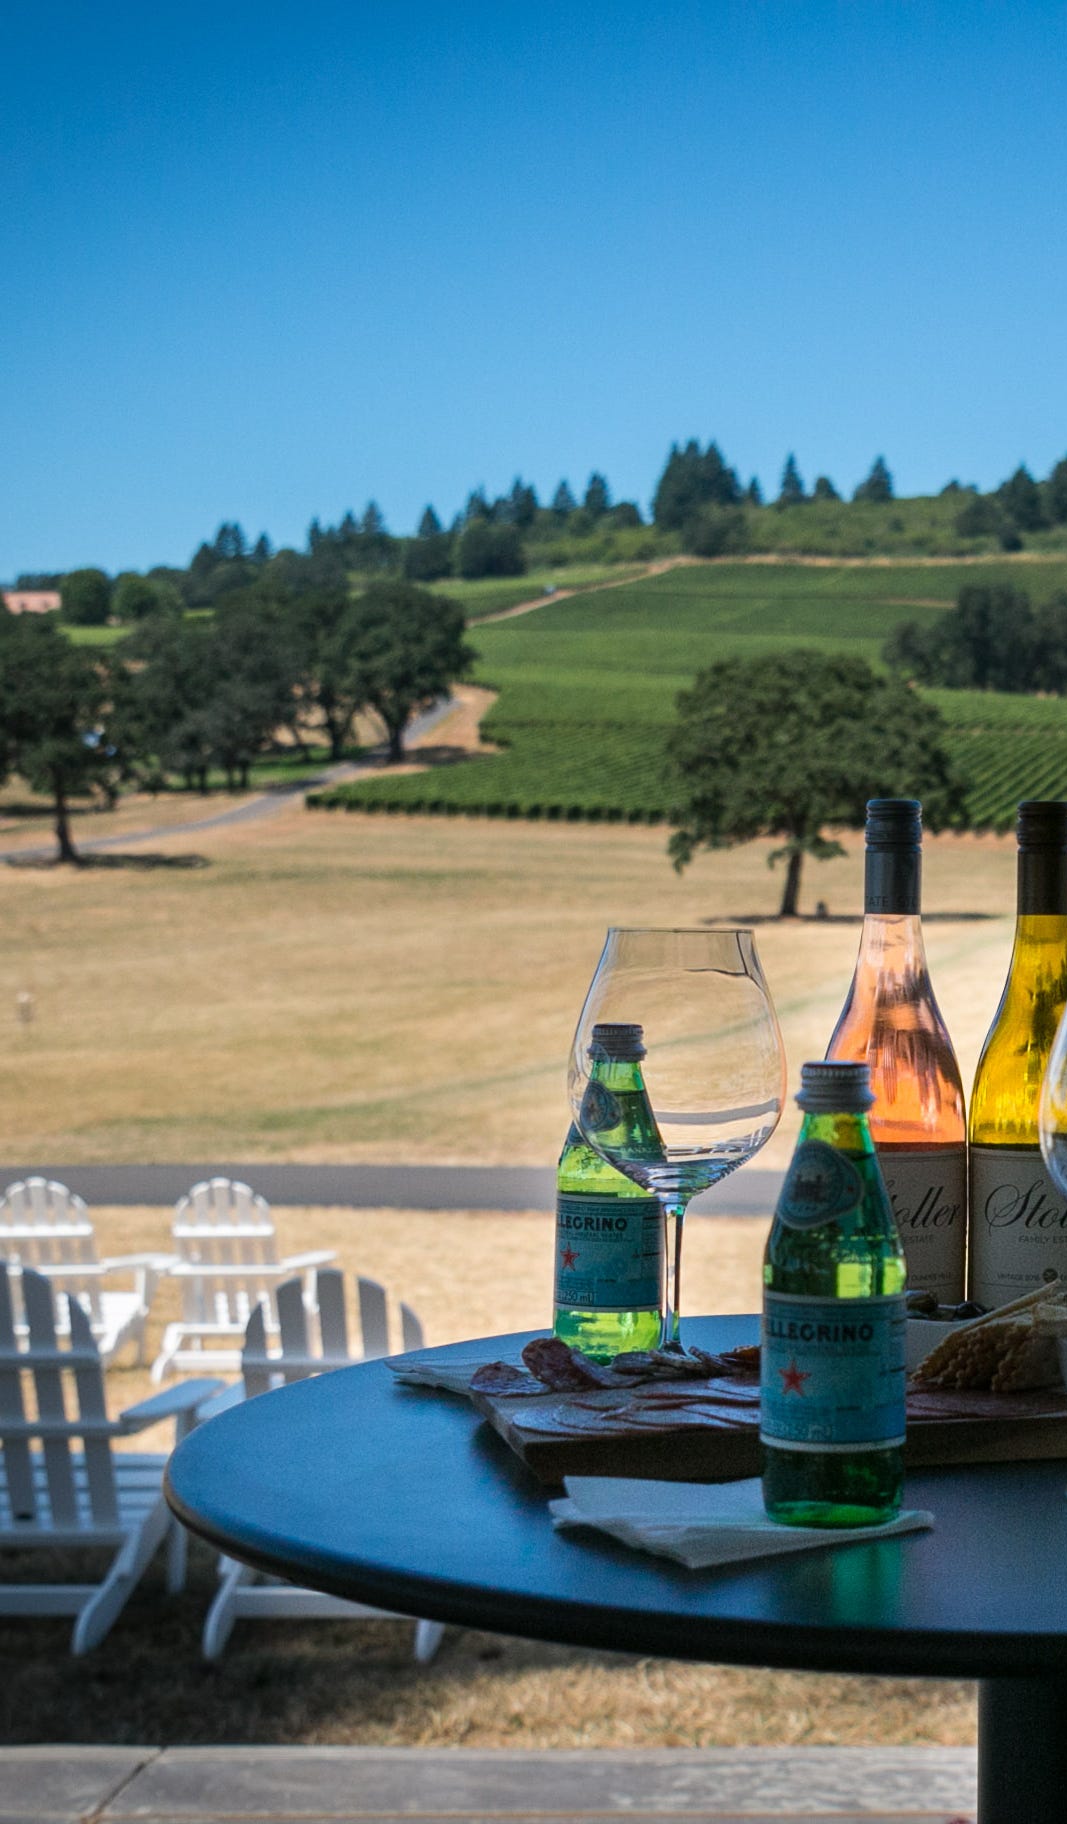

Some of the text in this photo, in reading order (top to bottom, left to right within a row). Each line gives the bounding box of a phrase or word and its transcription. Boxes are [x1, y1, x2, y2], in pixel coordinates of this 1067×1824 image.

[865, 895, 888, 907] ATE
[887, 1179, 961, 1229] oller
[557, 1214, 627, 1231] LEGRINO
[767, 1319, 874, 1341] LLEGRINO
